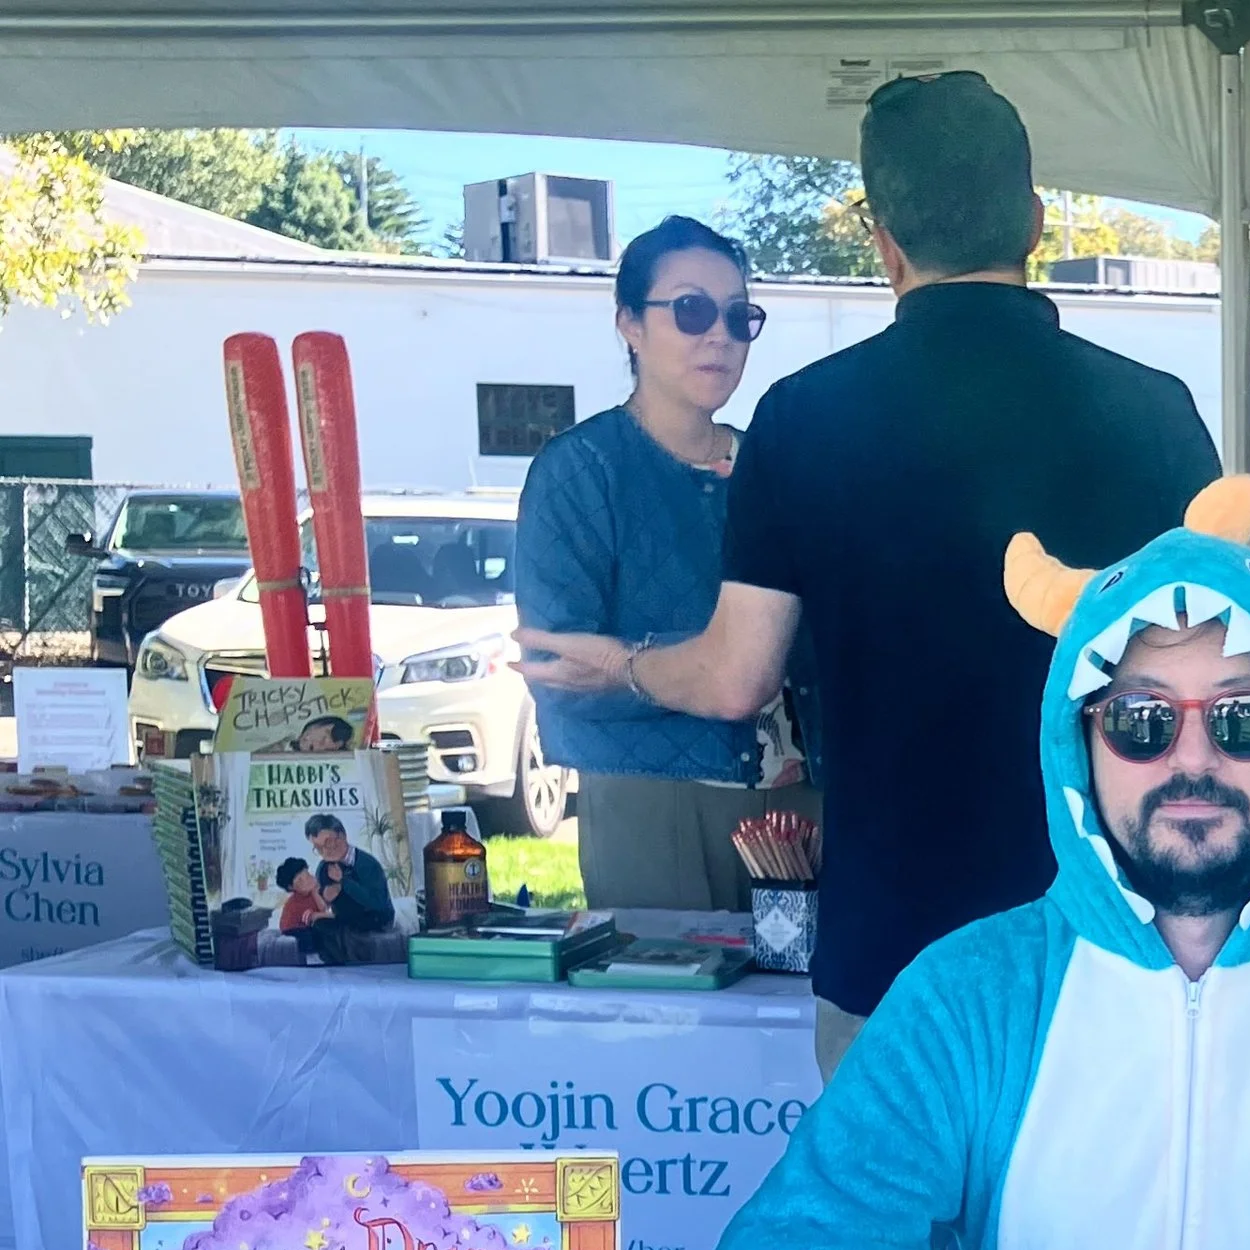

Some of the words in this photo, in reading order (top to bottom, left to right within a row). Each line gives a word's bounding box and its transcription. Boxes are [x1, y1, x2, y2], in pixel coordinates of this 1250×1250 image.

[175, 583, 213, 598] TOY
[233, 682, 307, 711] TRICKY
[267, 763, 342, 786] HABBI'S
[252, 786, 360, 809] TREASURES
[0, 847, 104, 889] Sylvia
[5, 887, 100, 927] Chen
[436, 1078, 617, 1142] Yoojin
[636, 1083, 807, 1136] Grace
